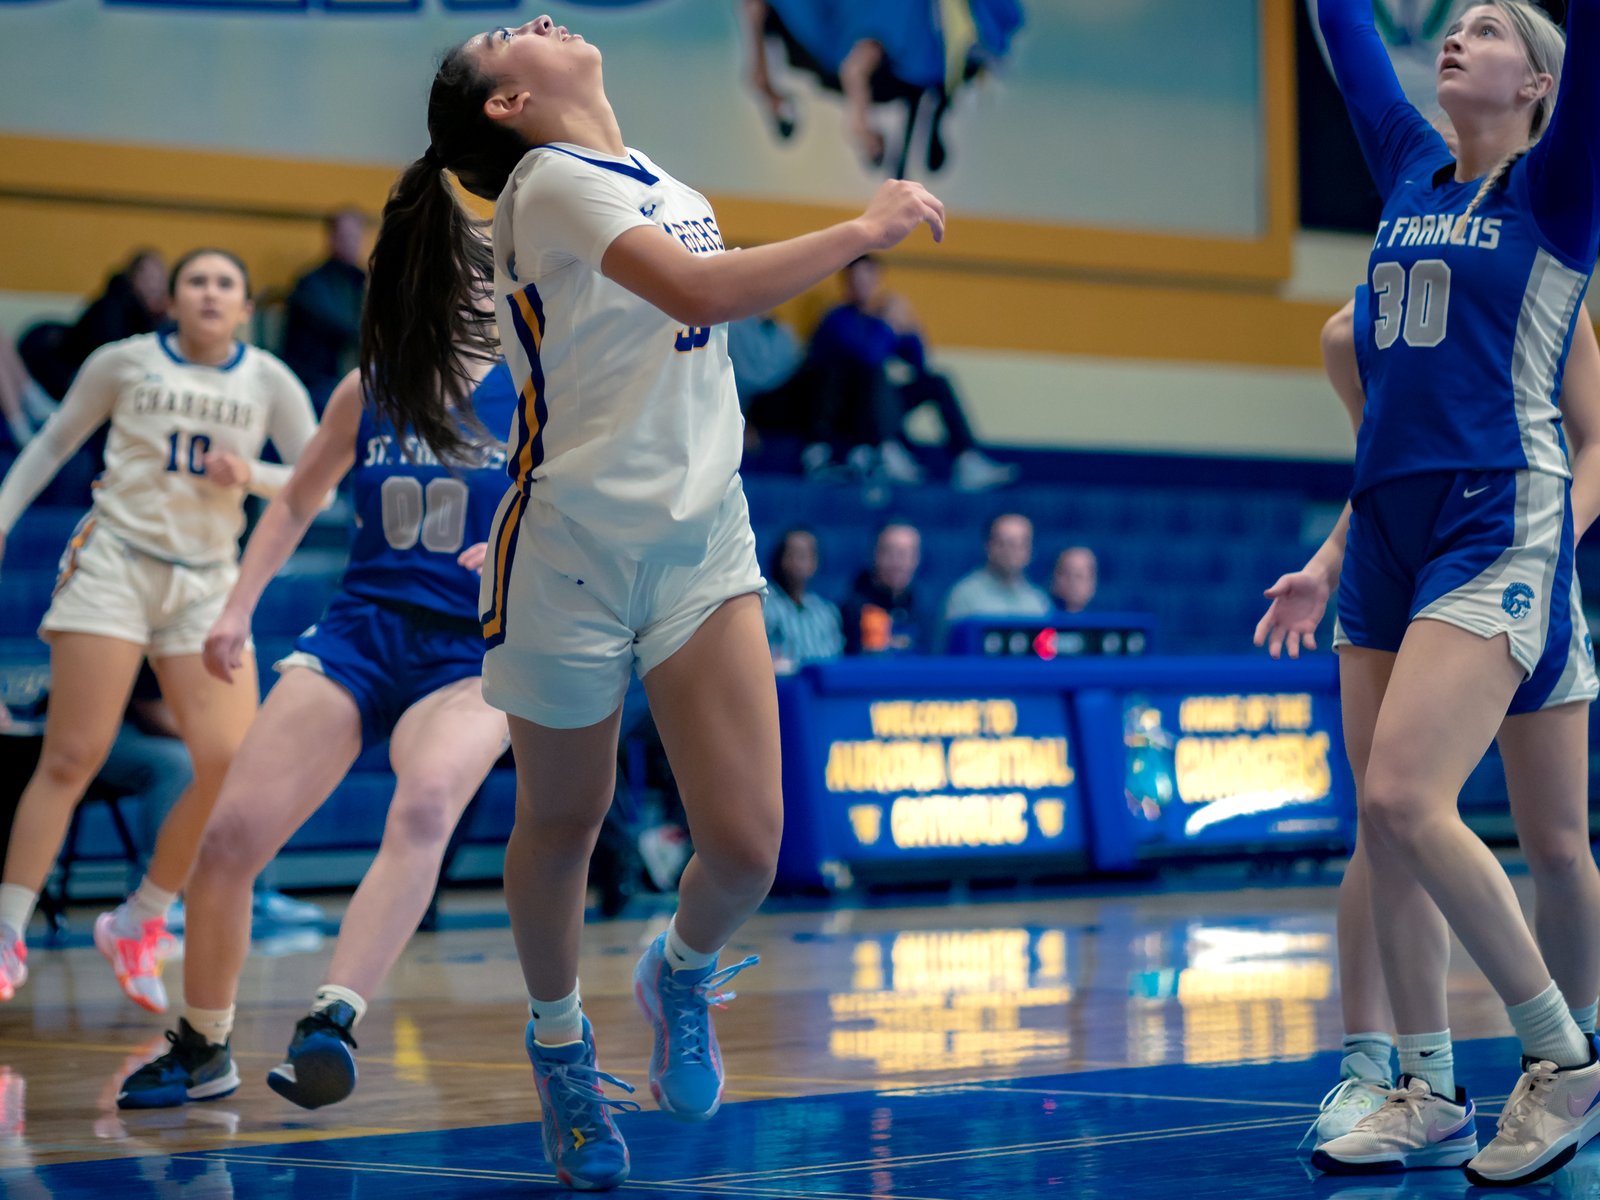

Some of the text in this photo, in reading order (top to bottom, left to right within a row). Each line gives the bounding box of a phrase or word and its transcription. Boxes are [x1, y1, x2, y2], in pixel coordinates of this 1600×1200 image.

[1372, 259, 1451, 350] 30
[166, 430, 211, 475] 10
[381, 475, 469, 554] 00
